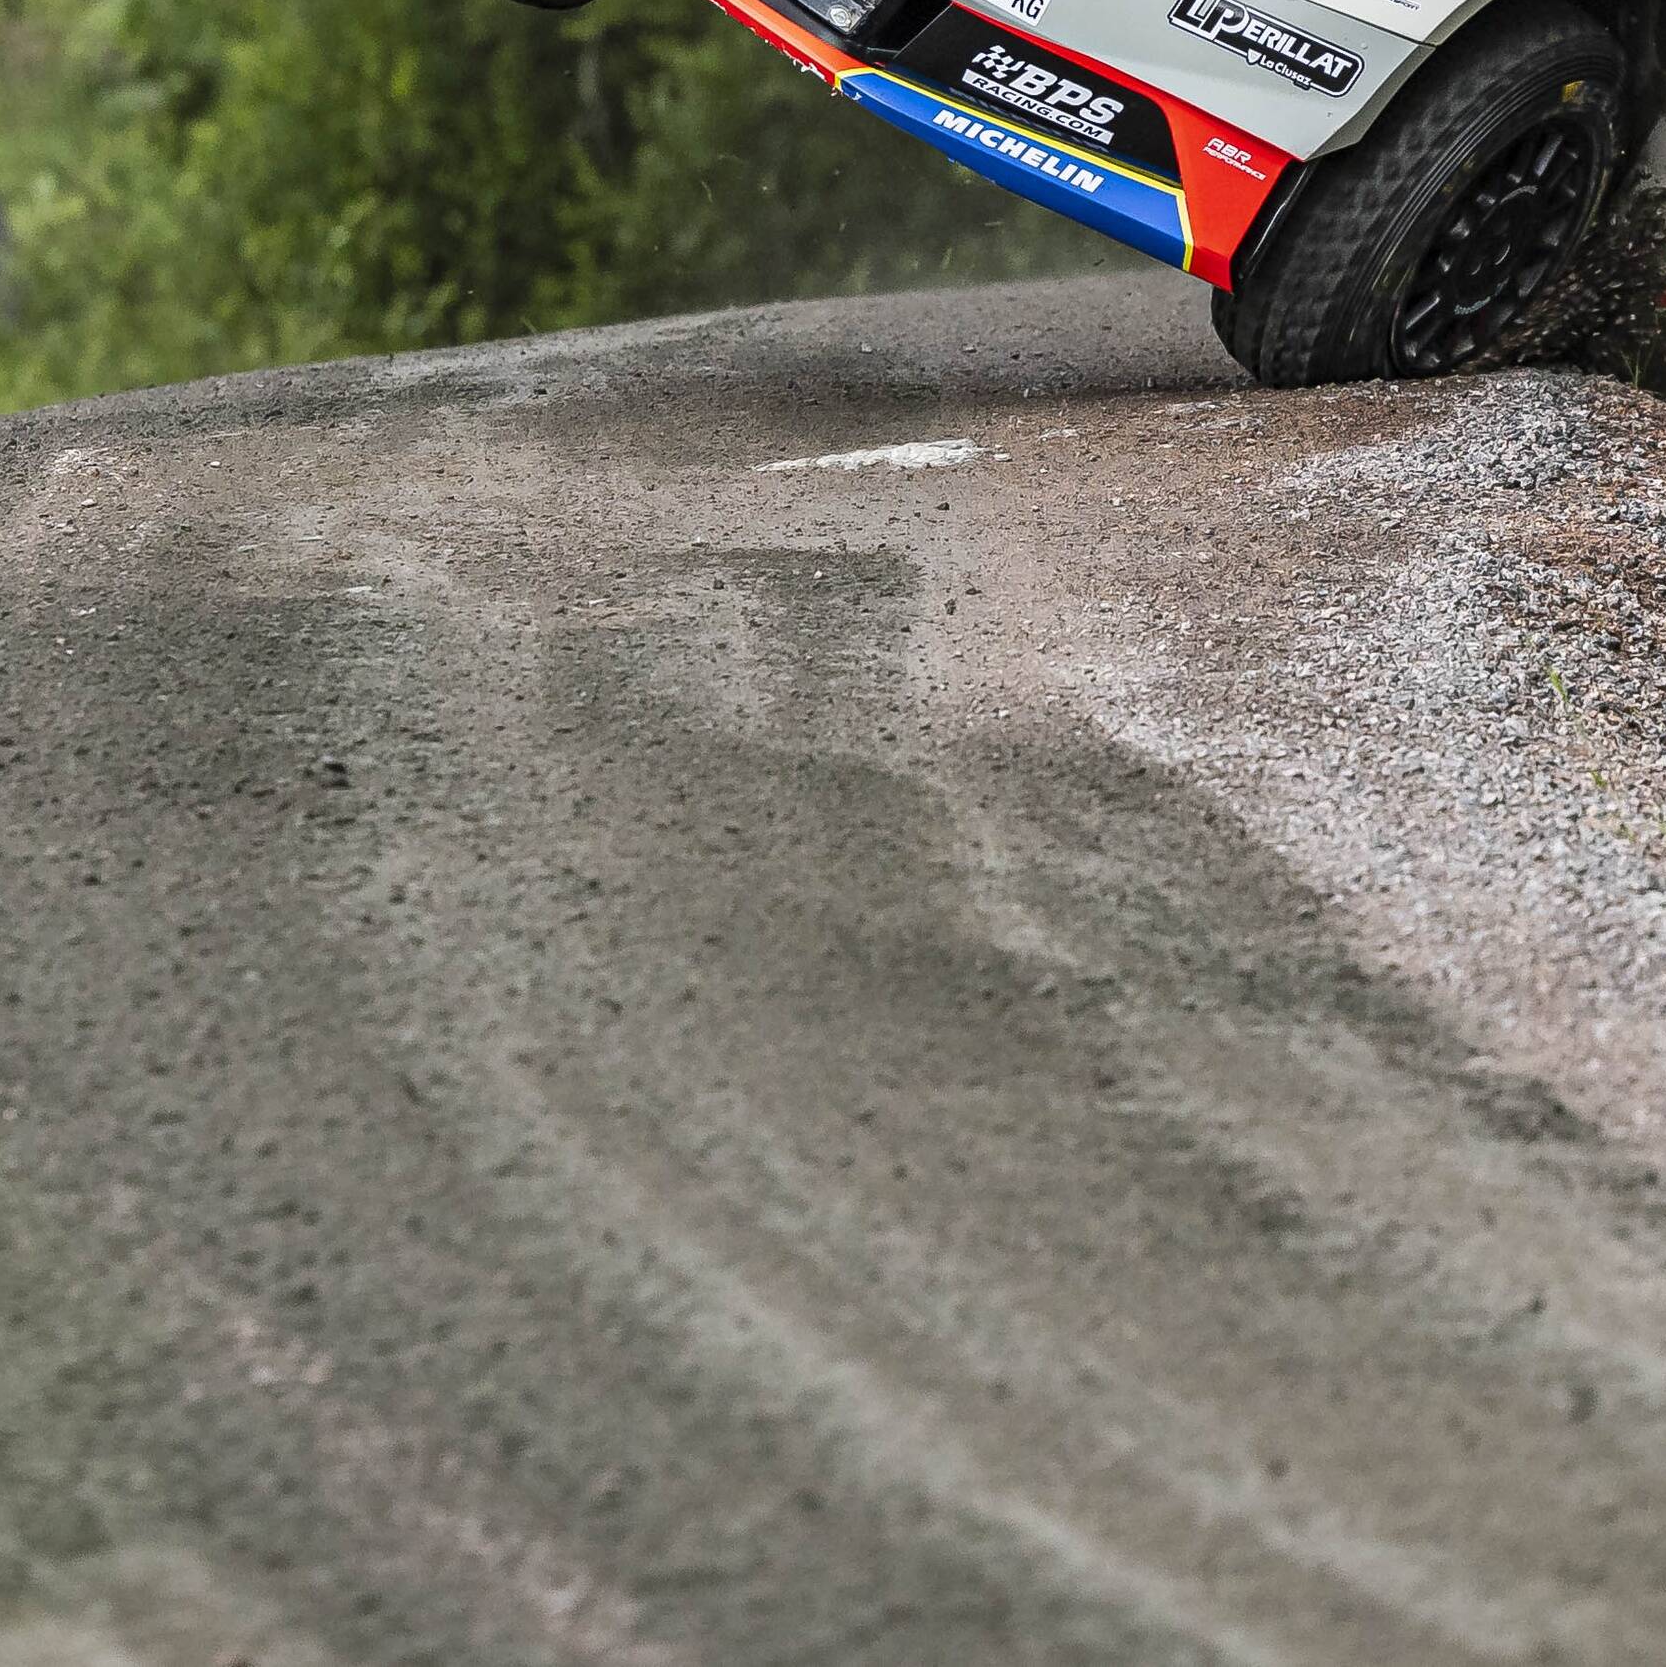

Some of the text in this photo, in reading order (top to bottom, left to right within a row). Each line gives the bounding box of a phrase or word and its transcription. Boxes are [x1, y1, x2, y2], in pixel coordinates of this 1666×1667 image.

[1008, 64, 1125, 125] BPS
[1260, 54, 1312, 87] La Clusaz
[971, 77, 1104, 139] RACING.COM
[933, 109, 1105, 194] MICHELIN
[1207, 137, 1252, 164] ABR
